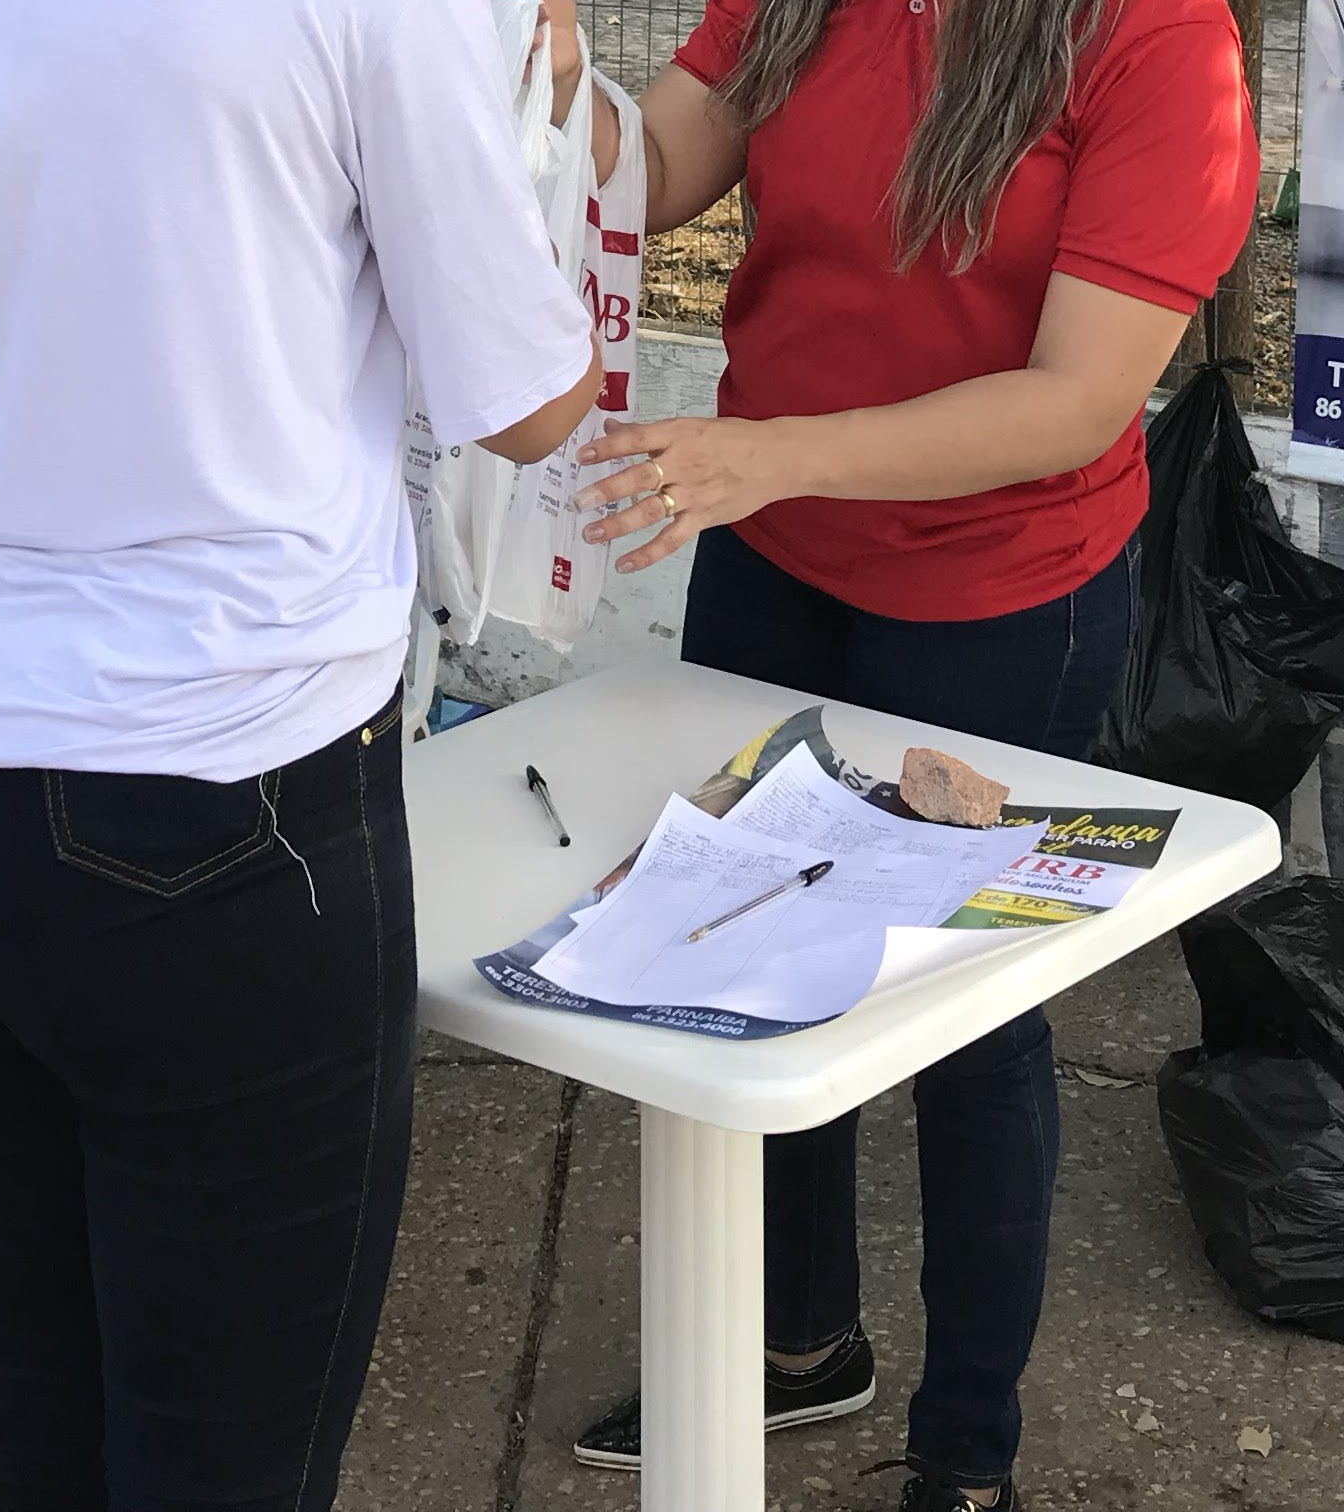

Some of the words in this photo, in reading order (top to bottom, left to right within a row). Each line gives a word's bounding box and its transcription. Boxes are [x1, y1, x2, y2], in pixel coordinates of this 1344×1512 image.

[1315, 397, 1341, 420] 86
[1072, 836, 1120, 849] PARA
[1121, 840, 1136, 850] O
[1008, 855, 1106, 881] IRB
